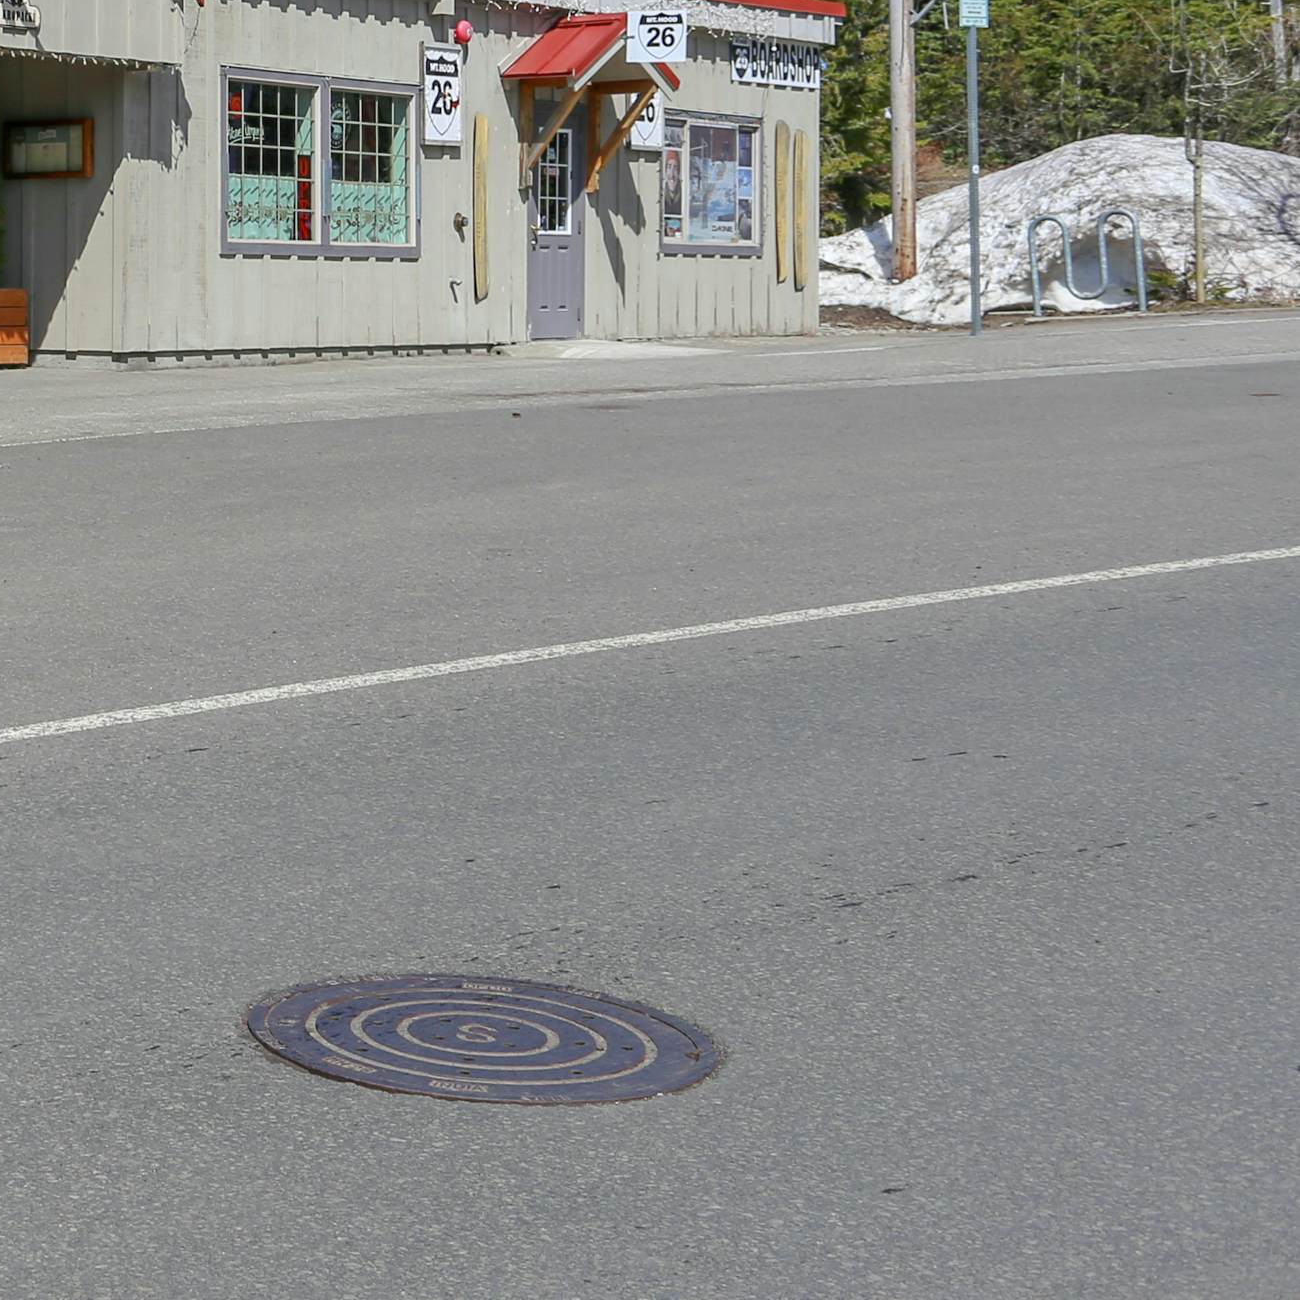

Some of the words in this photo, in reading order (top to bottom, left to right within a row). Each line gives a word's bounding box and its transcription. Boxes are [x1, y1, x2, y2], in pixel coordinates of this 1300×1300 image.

[646, 27, 675, 47] 26
[751, 40, 820, 84] BOARDSHOP
[431, 79, 454, 115] 26
